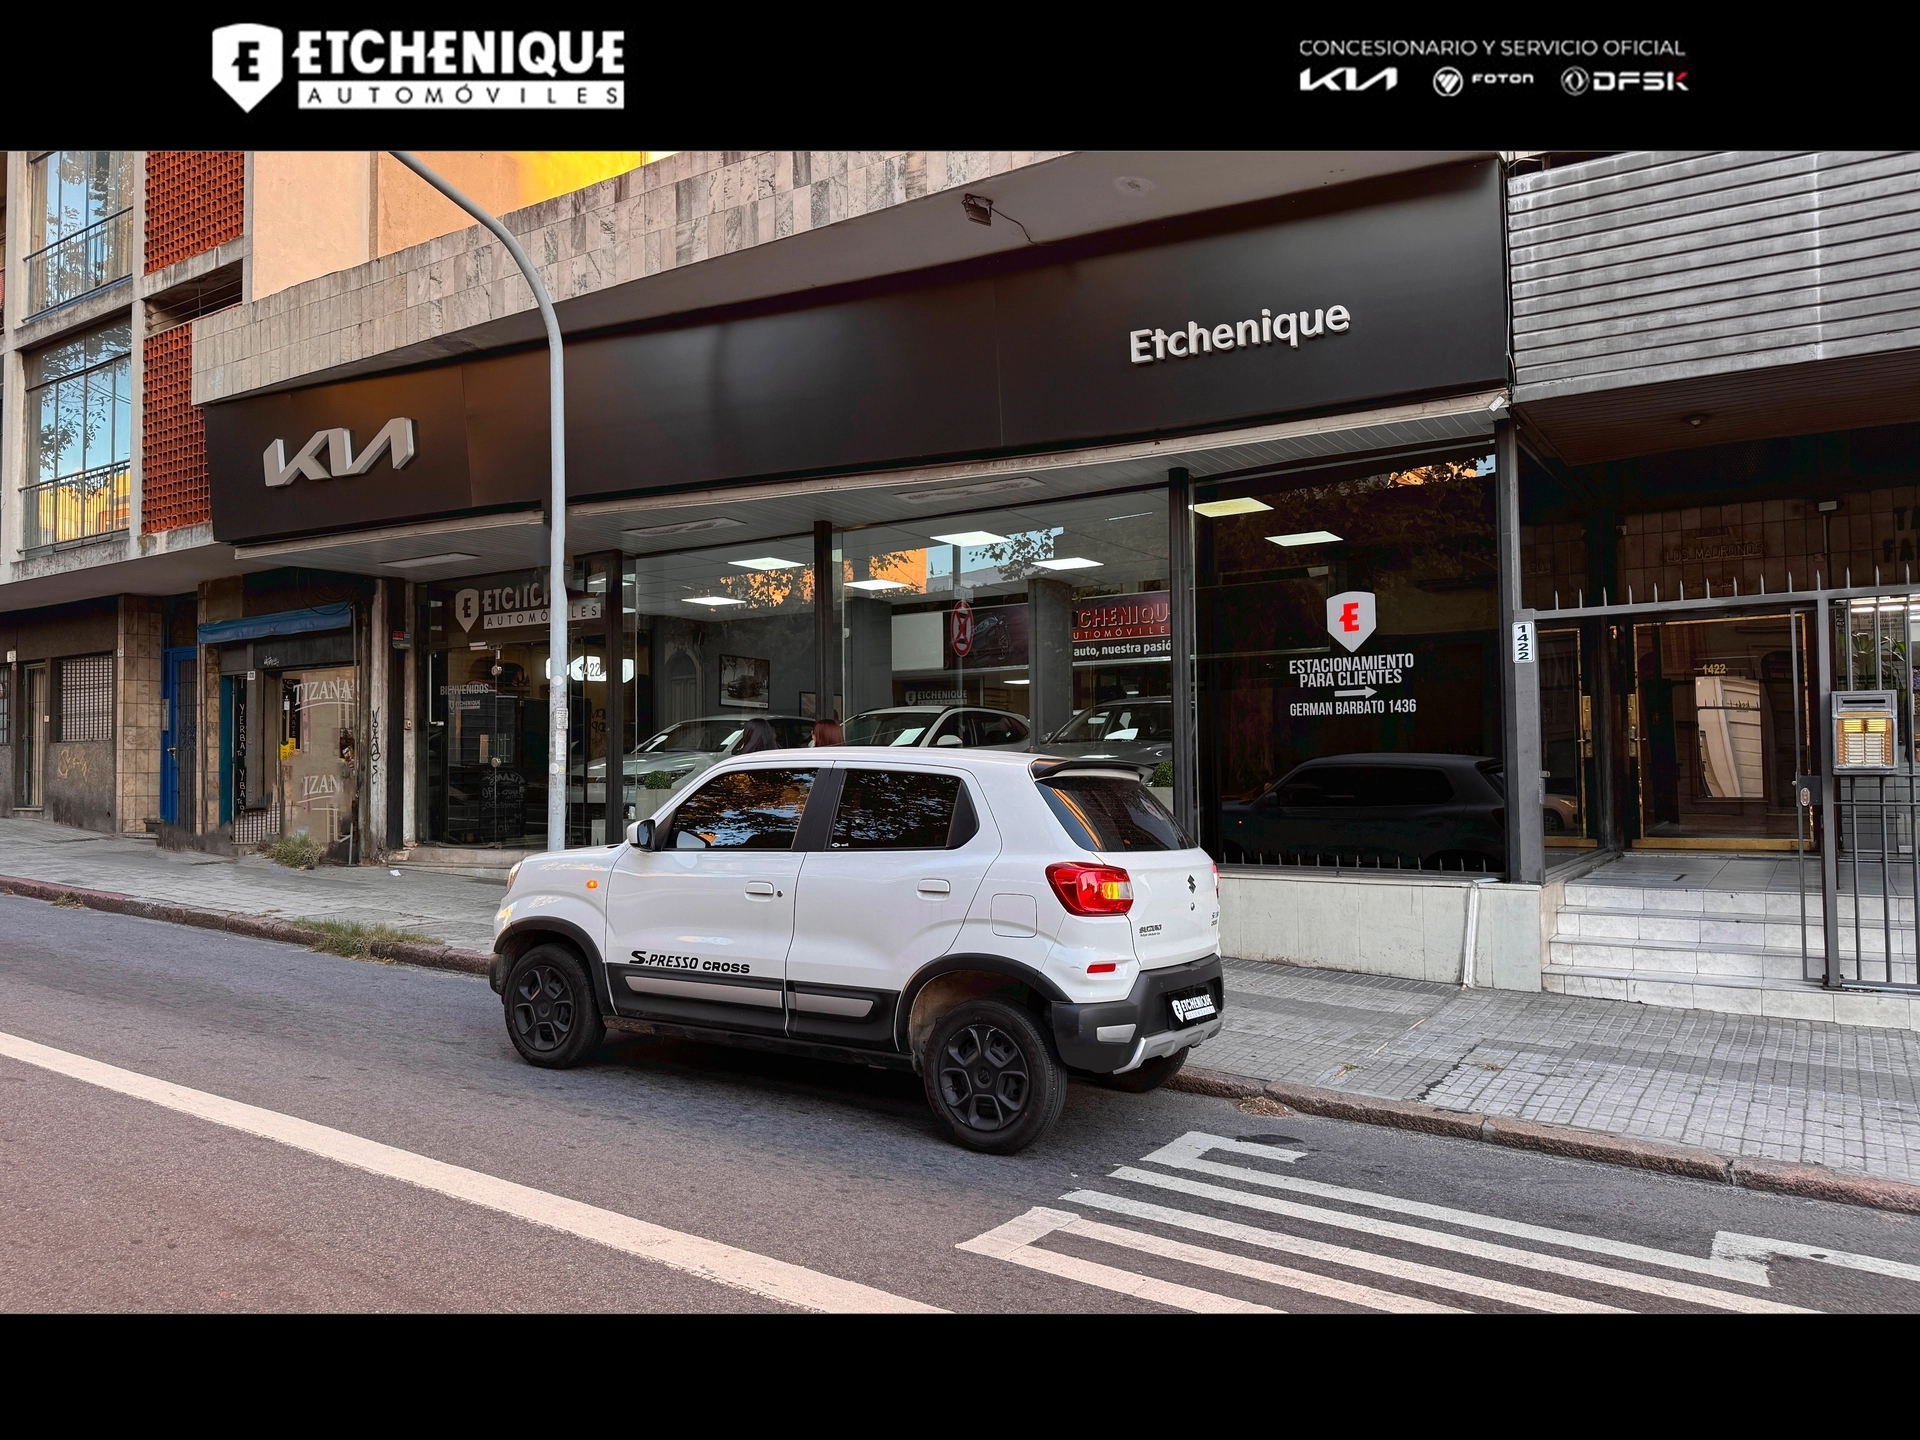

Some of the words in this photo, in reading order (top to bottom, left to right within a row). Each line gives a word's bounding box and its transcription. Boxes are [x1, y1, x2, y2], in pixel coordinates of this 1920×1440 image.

[1130, 304, 1350, 365] Etchenique
[263, 417, 415, 488] KIA
[1073, 646, 1099, 657] auto,
[1102, 643, 1141, 655] nuestra
[1517, 624, 1530, 661] 1422
[1289, 653, 1414, 675] ESTACIONAMIENTO
[1702, 663, 1727, 675] 1422
[1300, 672, 1334, 688] PARA
[1338, 668, 1402, 686] CLIENTES
[439, 684, 489, 696] BIENVENIDOS
[917, 690, 968, 700] ETCHENIQUE
[1290, 702, 1333, 716] GERMAN
[1336, 700, 1384, 715] BARBATO
[1389, 698, 1417, 713] 1436
[702, 961, 751, 974] CROSS
